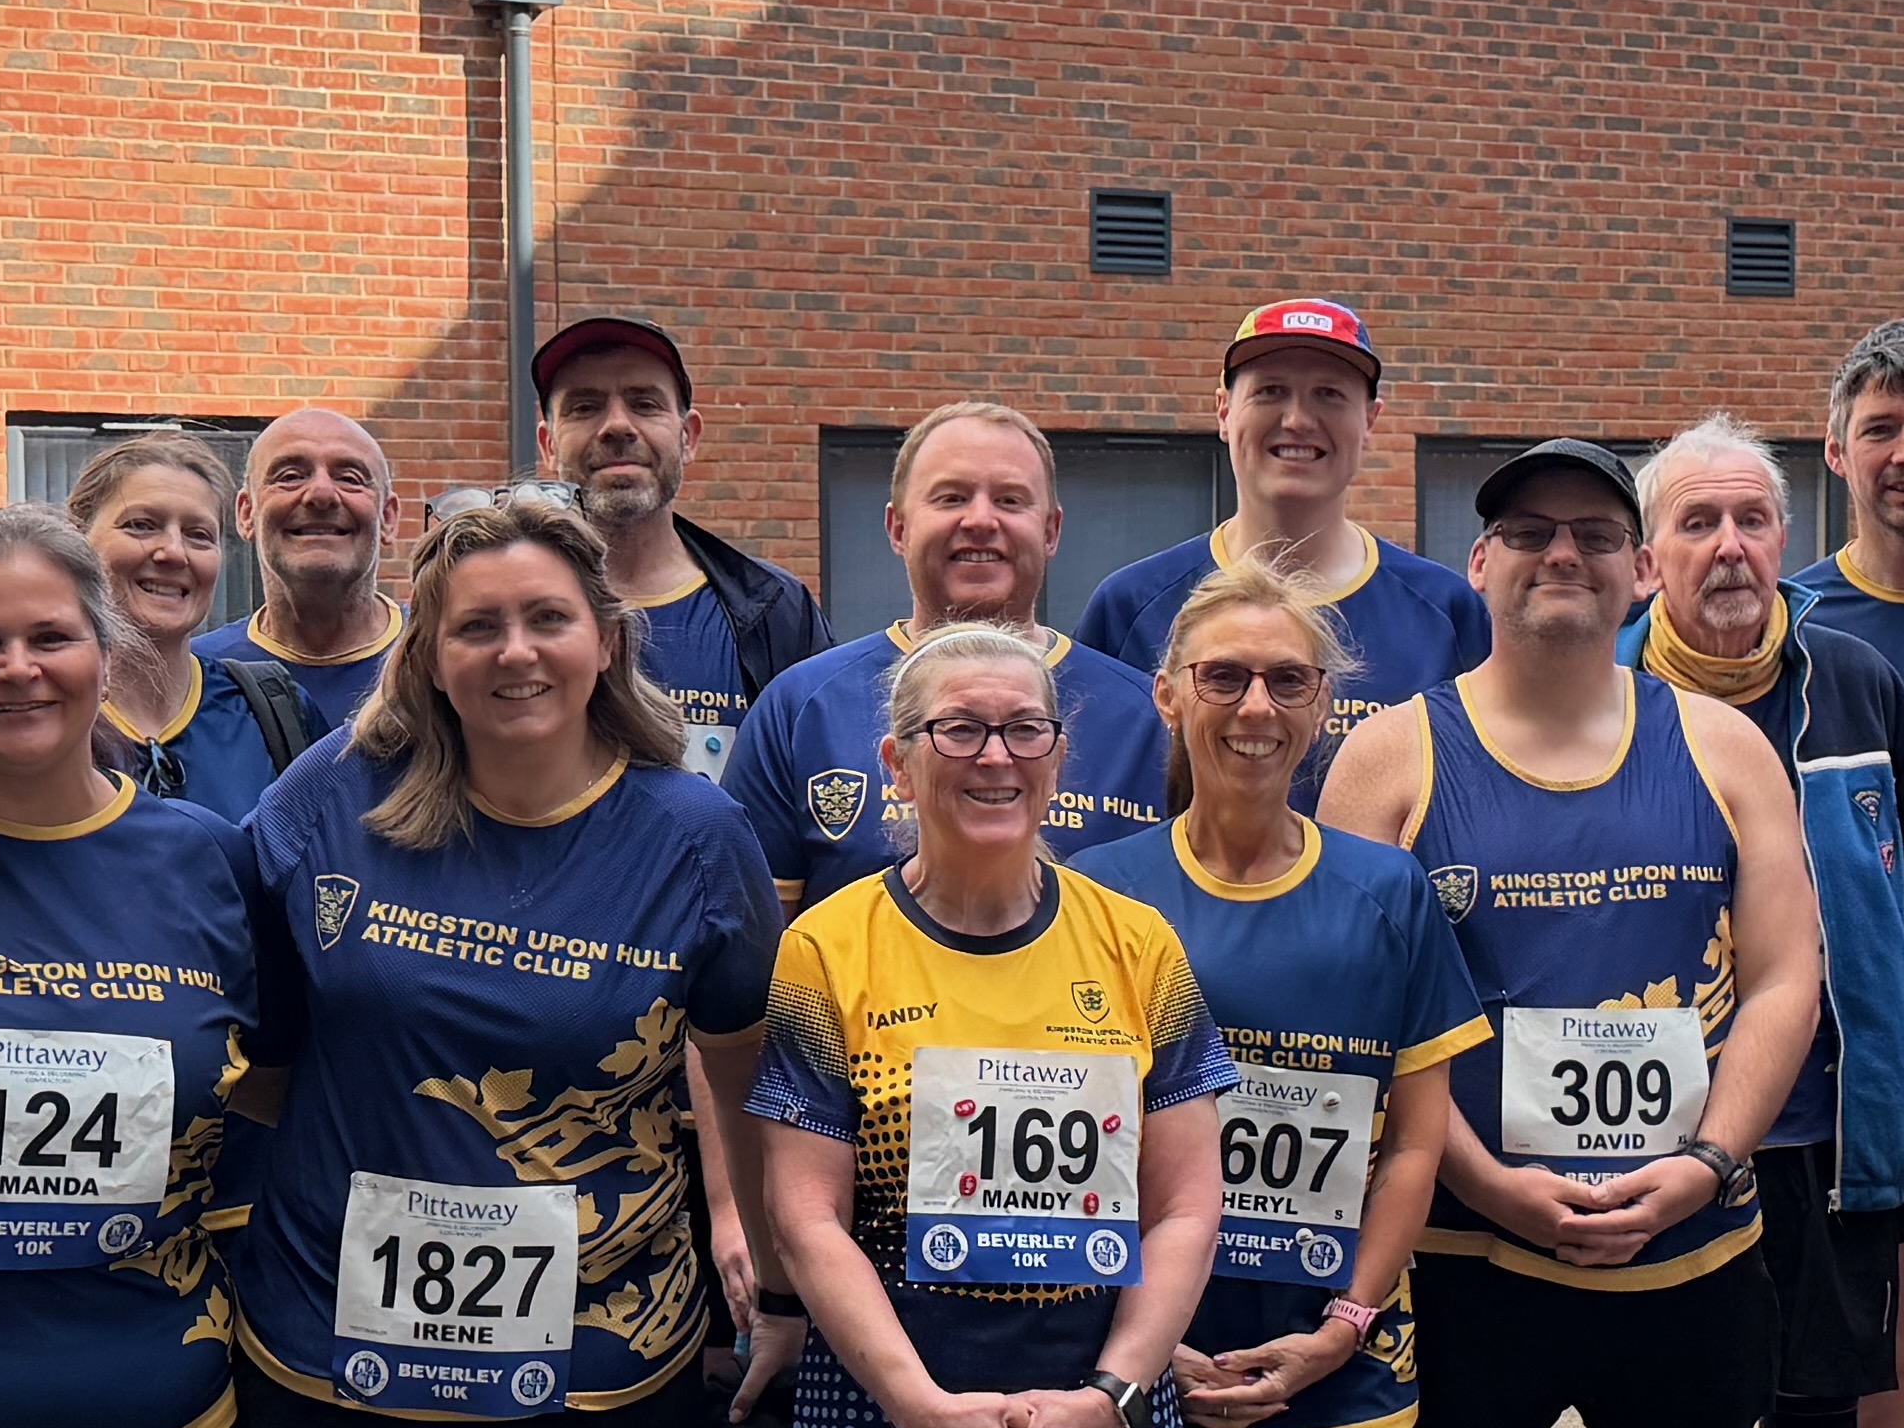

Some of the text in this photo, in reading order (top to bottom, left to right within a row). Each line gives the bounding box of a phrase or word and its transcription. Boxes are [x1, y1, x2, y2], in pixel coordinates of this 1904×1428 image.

[670, 689, 729, 708] UPON
[1333, 698, 1390, 716] UPO
[1325, 717, 1361, 735] CL
[1039, 809, 1084, 829] UB
[1103, 796, 1161, 823] HULL
[1491, 865, 1724, 890] KINGSTON UPON HULL
[1493, 883, 1667, 908] ATHLETIC CLUB
[367, 900, 683, 971] KINGSTON UPON HULL
[361, 923, 590, 980] ATHLETIC CLUB
[96, 961, 171, 984] UPON
[177, 967, 224, 996] HULL
[90, 982, 165, 1002] CLUB
[1562, 1017, 1657, 1043] Pittaway
[1280, 1031, 1343, 1053] UPON
[1348, 1036, 1392, 1057] HULL
[1271, 1050, 1333, 1071] CLUB
[978, 1058, 1089, 1090] Pittaway
[1550, 1059, 1673, 1127] 309
[967, 1105, 1099, 1184] 169
[1576, 1133, 1646, 1150] DAVID
[1220, 1117, 1349, 1193] 607
[408, 1190, 519, 1227] Pittaway
[982, 1189, 1121, 1213] MANDY S
[1334, 1209, 1344, 1221] S
[15, 1240, 53, 1256] 10K
[977, 1232, 1077, 1251] BEVERLEY
[1011, 1252, 1047, 1268] 10K
[1228, 1249, 1262, 1267] 10K
[372, 1235, 556, 1319] 1827
[413, 1321, 554, 1345] IRENE L
[398, 1362, 503, 1384] BEVERLEY
[431, 1384, 468, 1400] 10K
